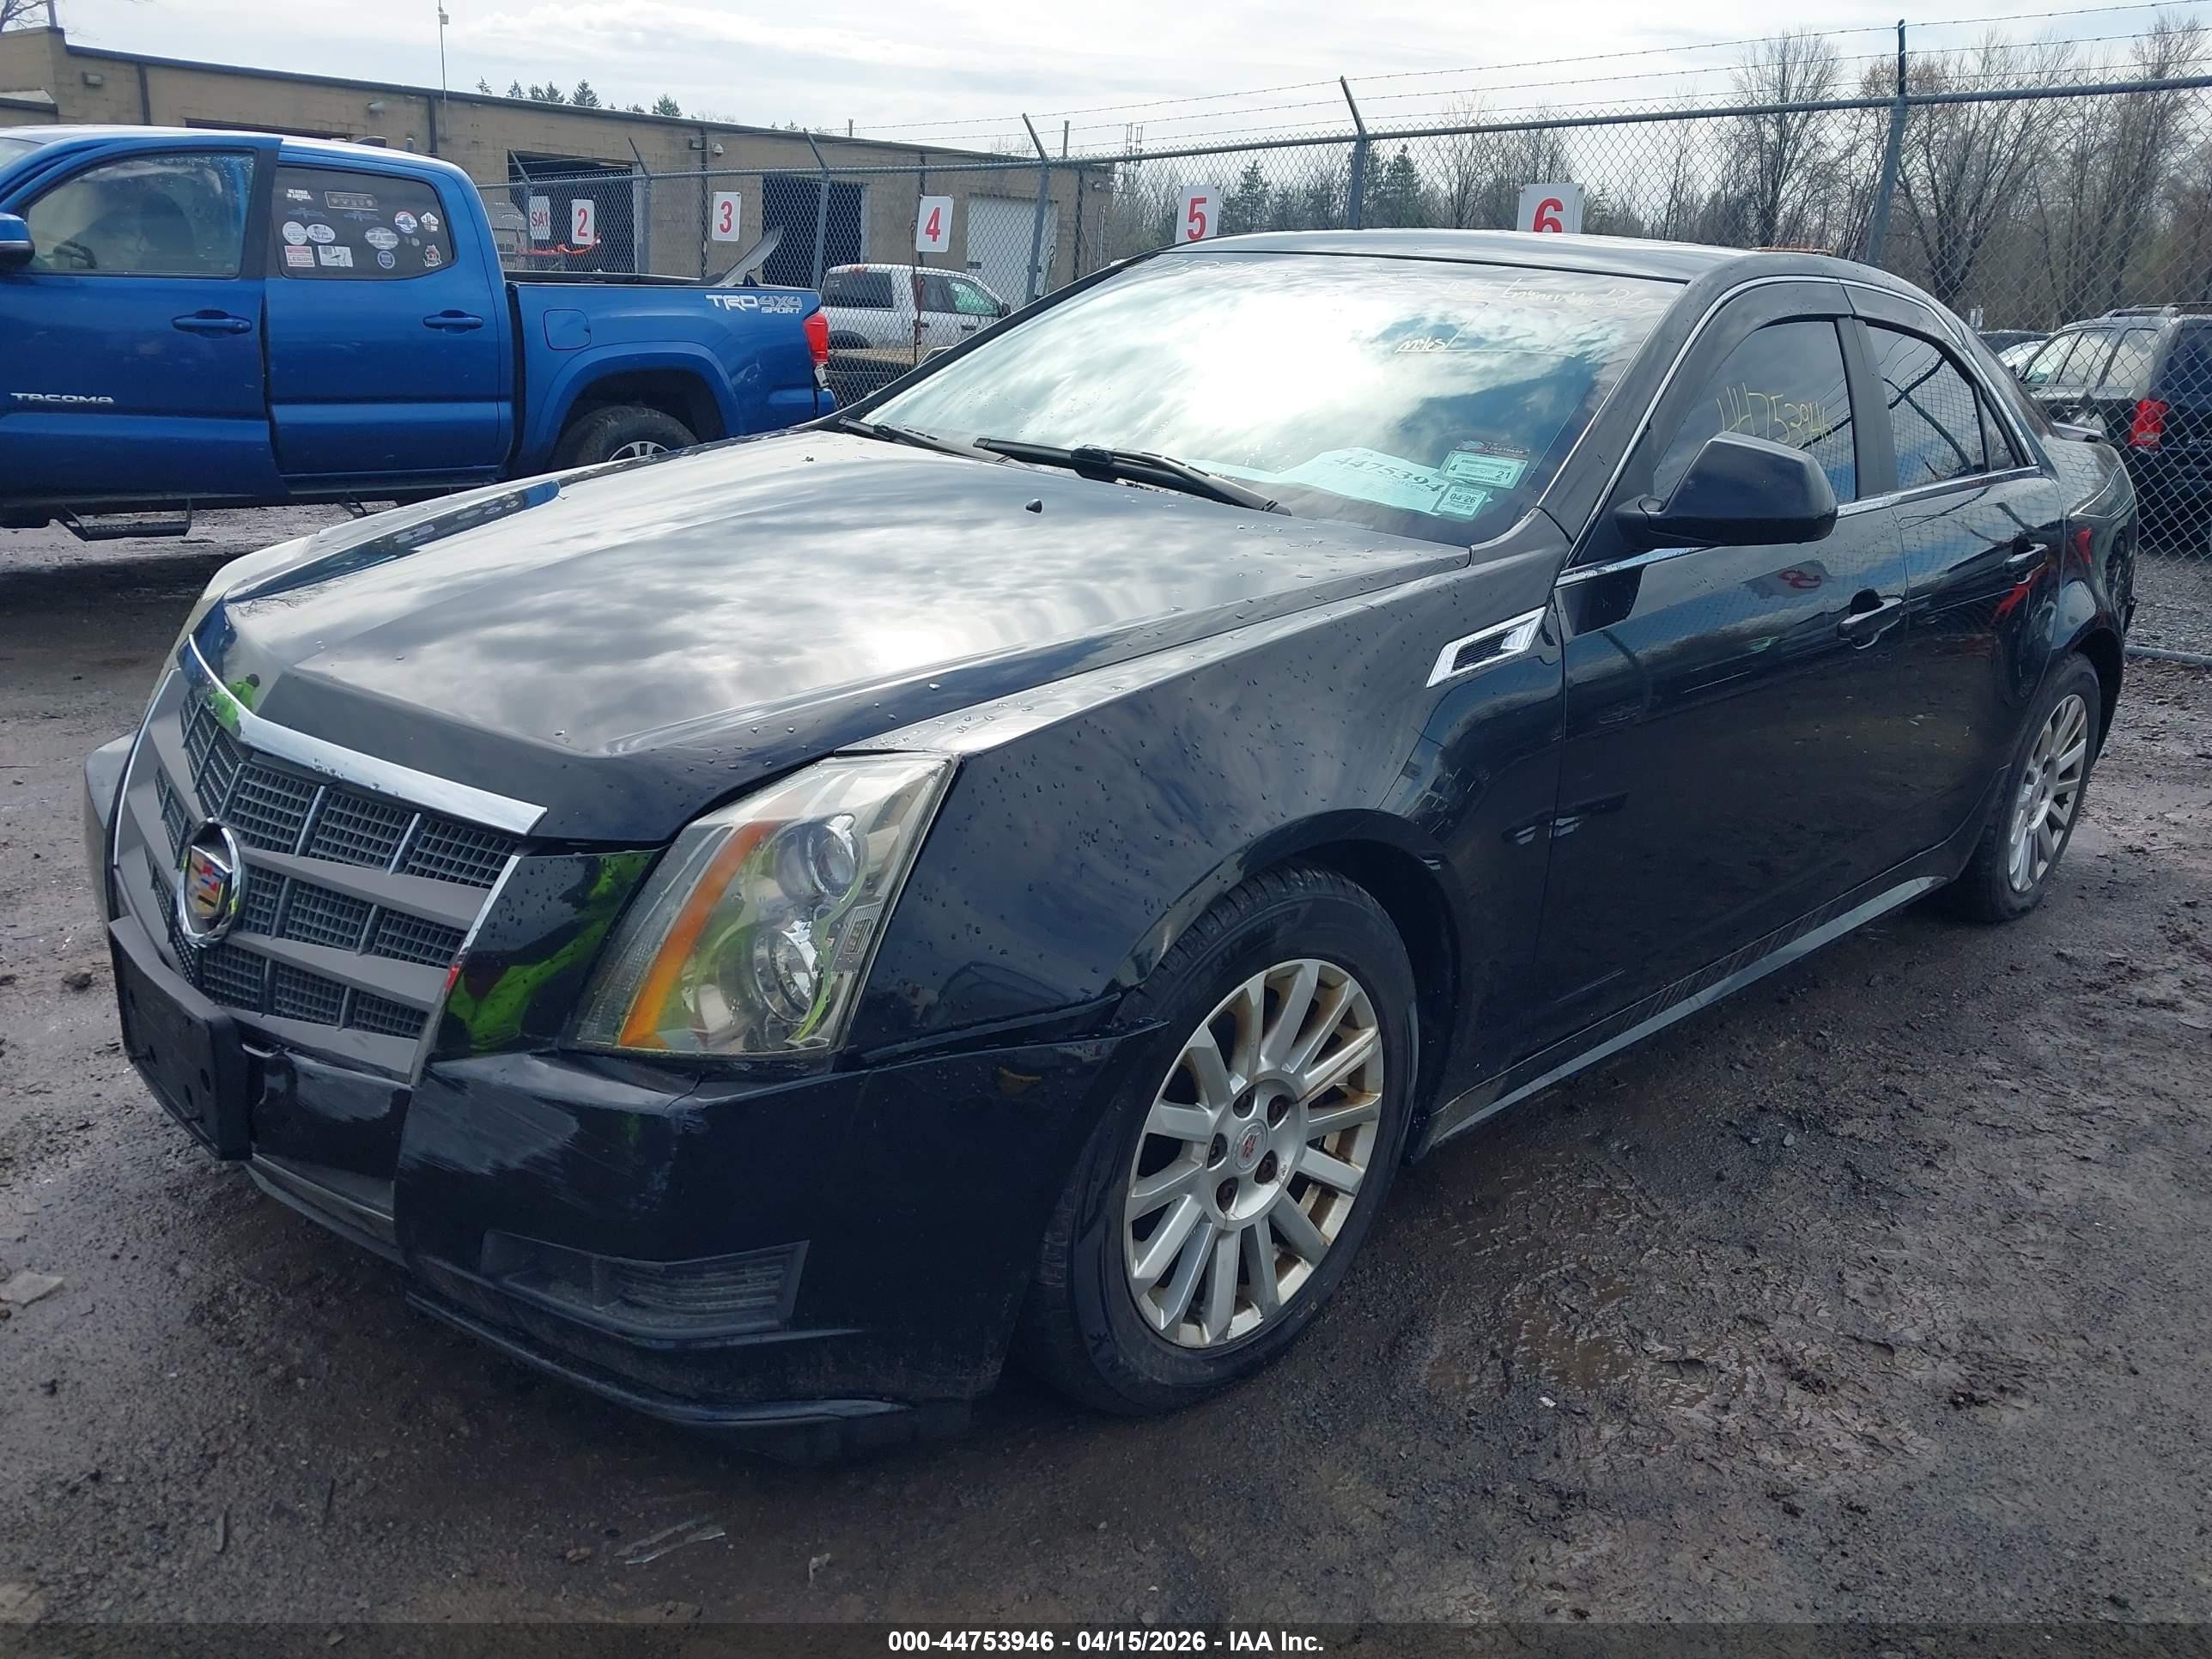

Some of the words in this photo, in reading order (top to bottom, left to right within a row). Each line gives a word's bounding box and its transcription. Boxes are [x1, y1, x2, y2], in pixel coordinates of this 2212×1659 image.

[532, 211, 549, 228] SA1
[577, 207, 588, 237] 2
[720, 200, 732, 234] 3
[925, 206, 941, 242] 4
[1188, 197, 1206, 240] 5
[1533, 198, 1564, 234] 6
[705, 294, 758, 311] TRD
[9, 392, 115, 404] TACOMA
[1496, 471, 1512, 480] 21
